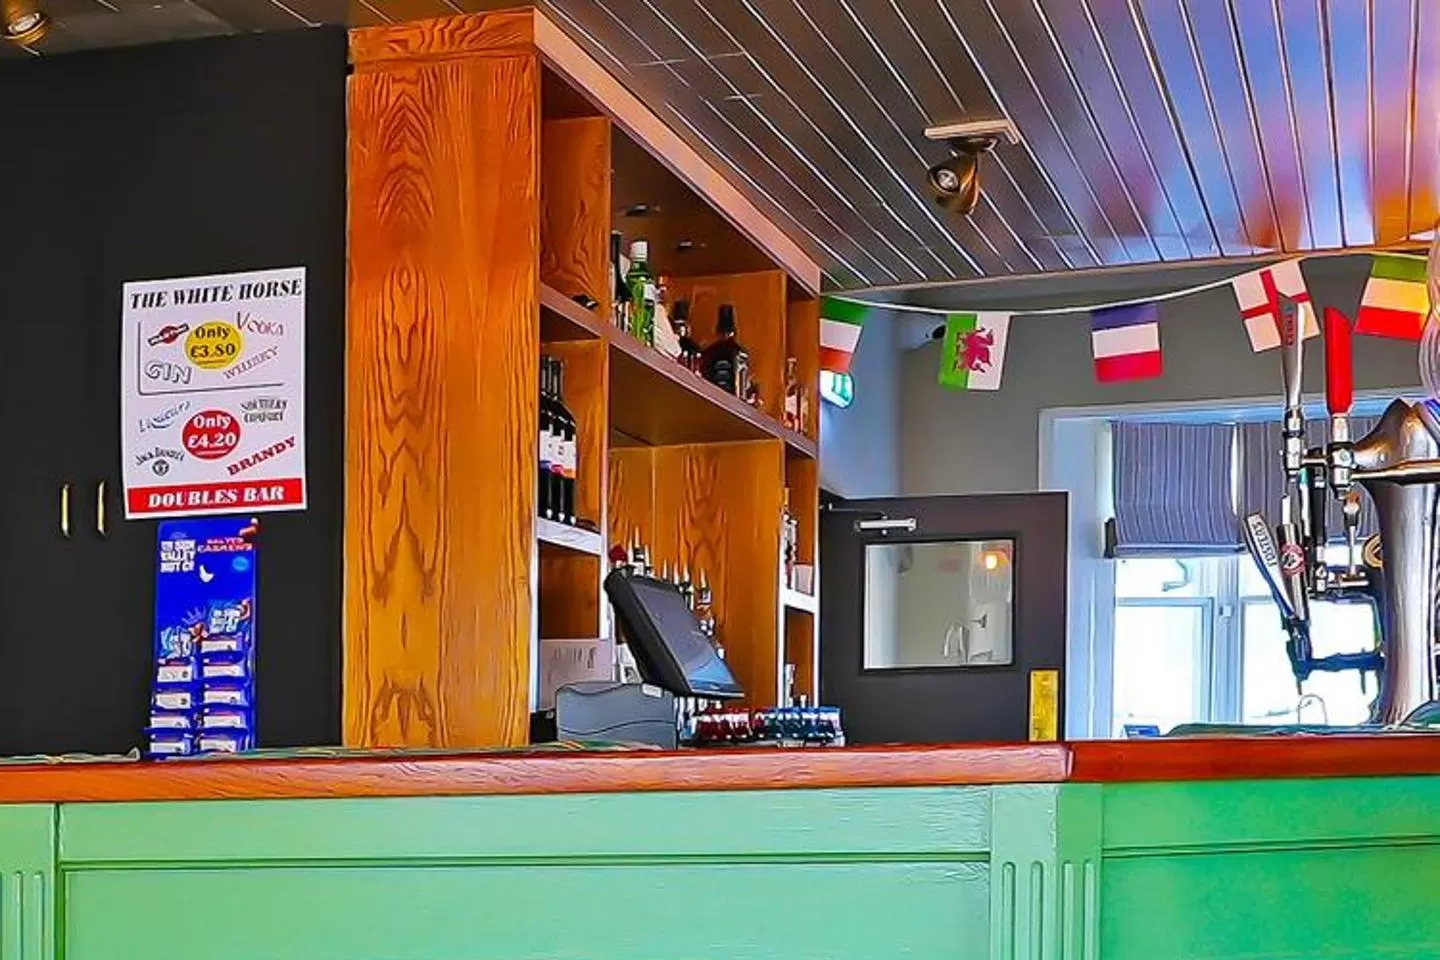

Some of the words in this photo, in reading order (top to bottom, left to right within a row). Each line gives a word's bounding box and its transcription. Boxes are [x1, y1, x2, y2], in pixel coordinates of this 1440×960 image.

[131, 291, 168, 309] THE
[173, 284, 233, 305] WHITE
[239, 279, 302, 300] HORSE
[196, 326, 230, 340] Only
[145, 360, 192, 384] GIN
[193, 414, 231, 429] Only
[188, 432, 237, 449] £4.20
[226, 436, 295, 476] BRANDY
[148, 488, 238, 508] DOUBLES
[243, 486, 285, 503] BAR
